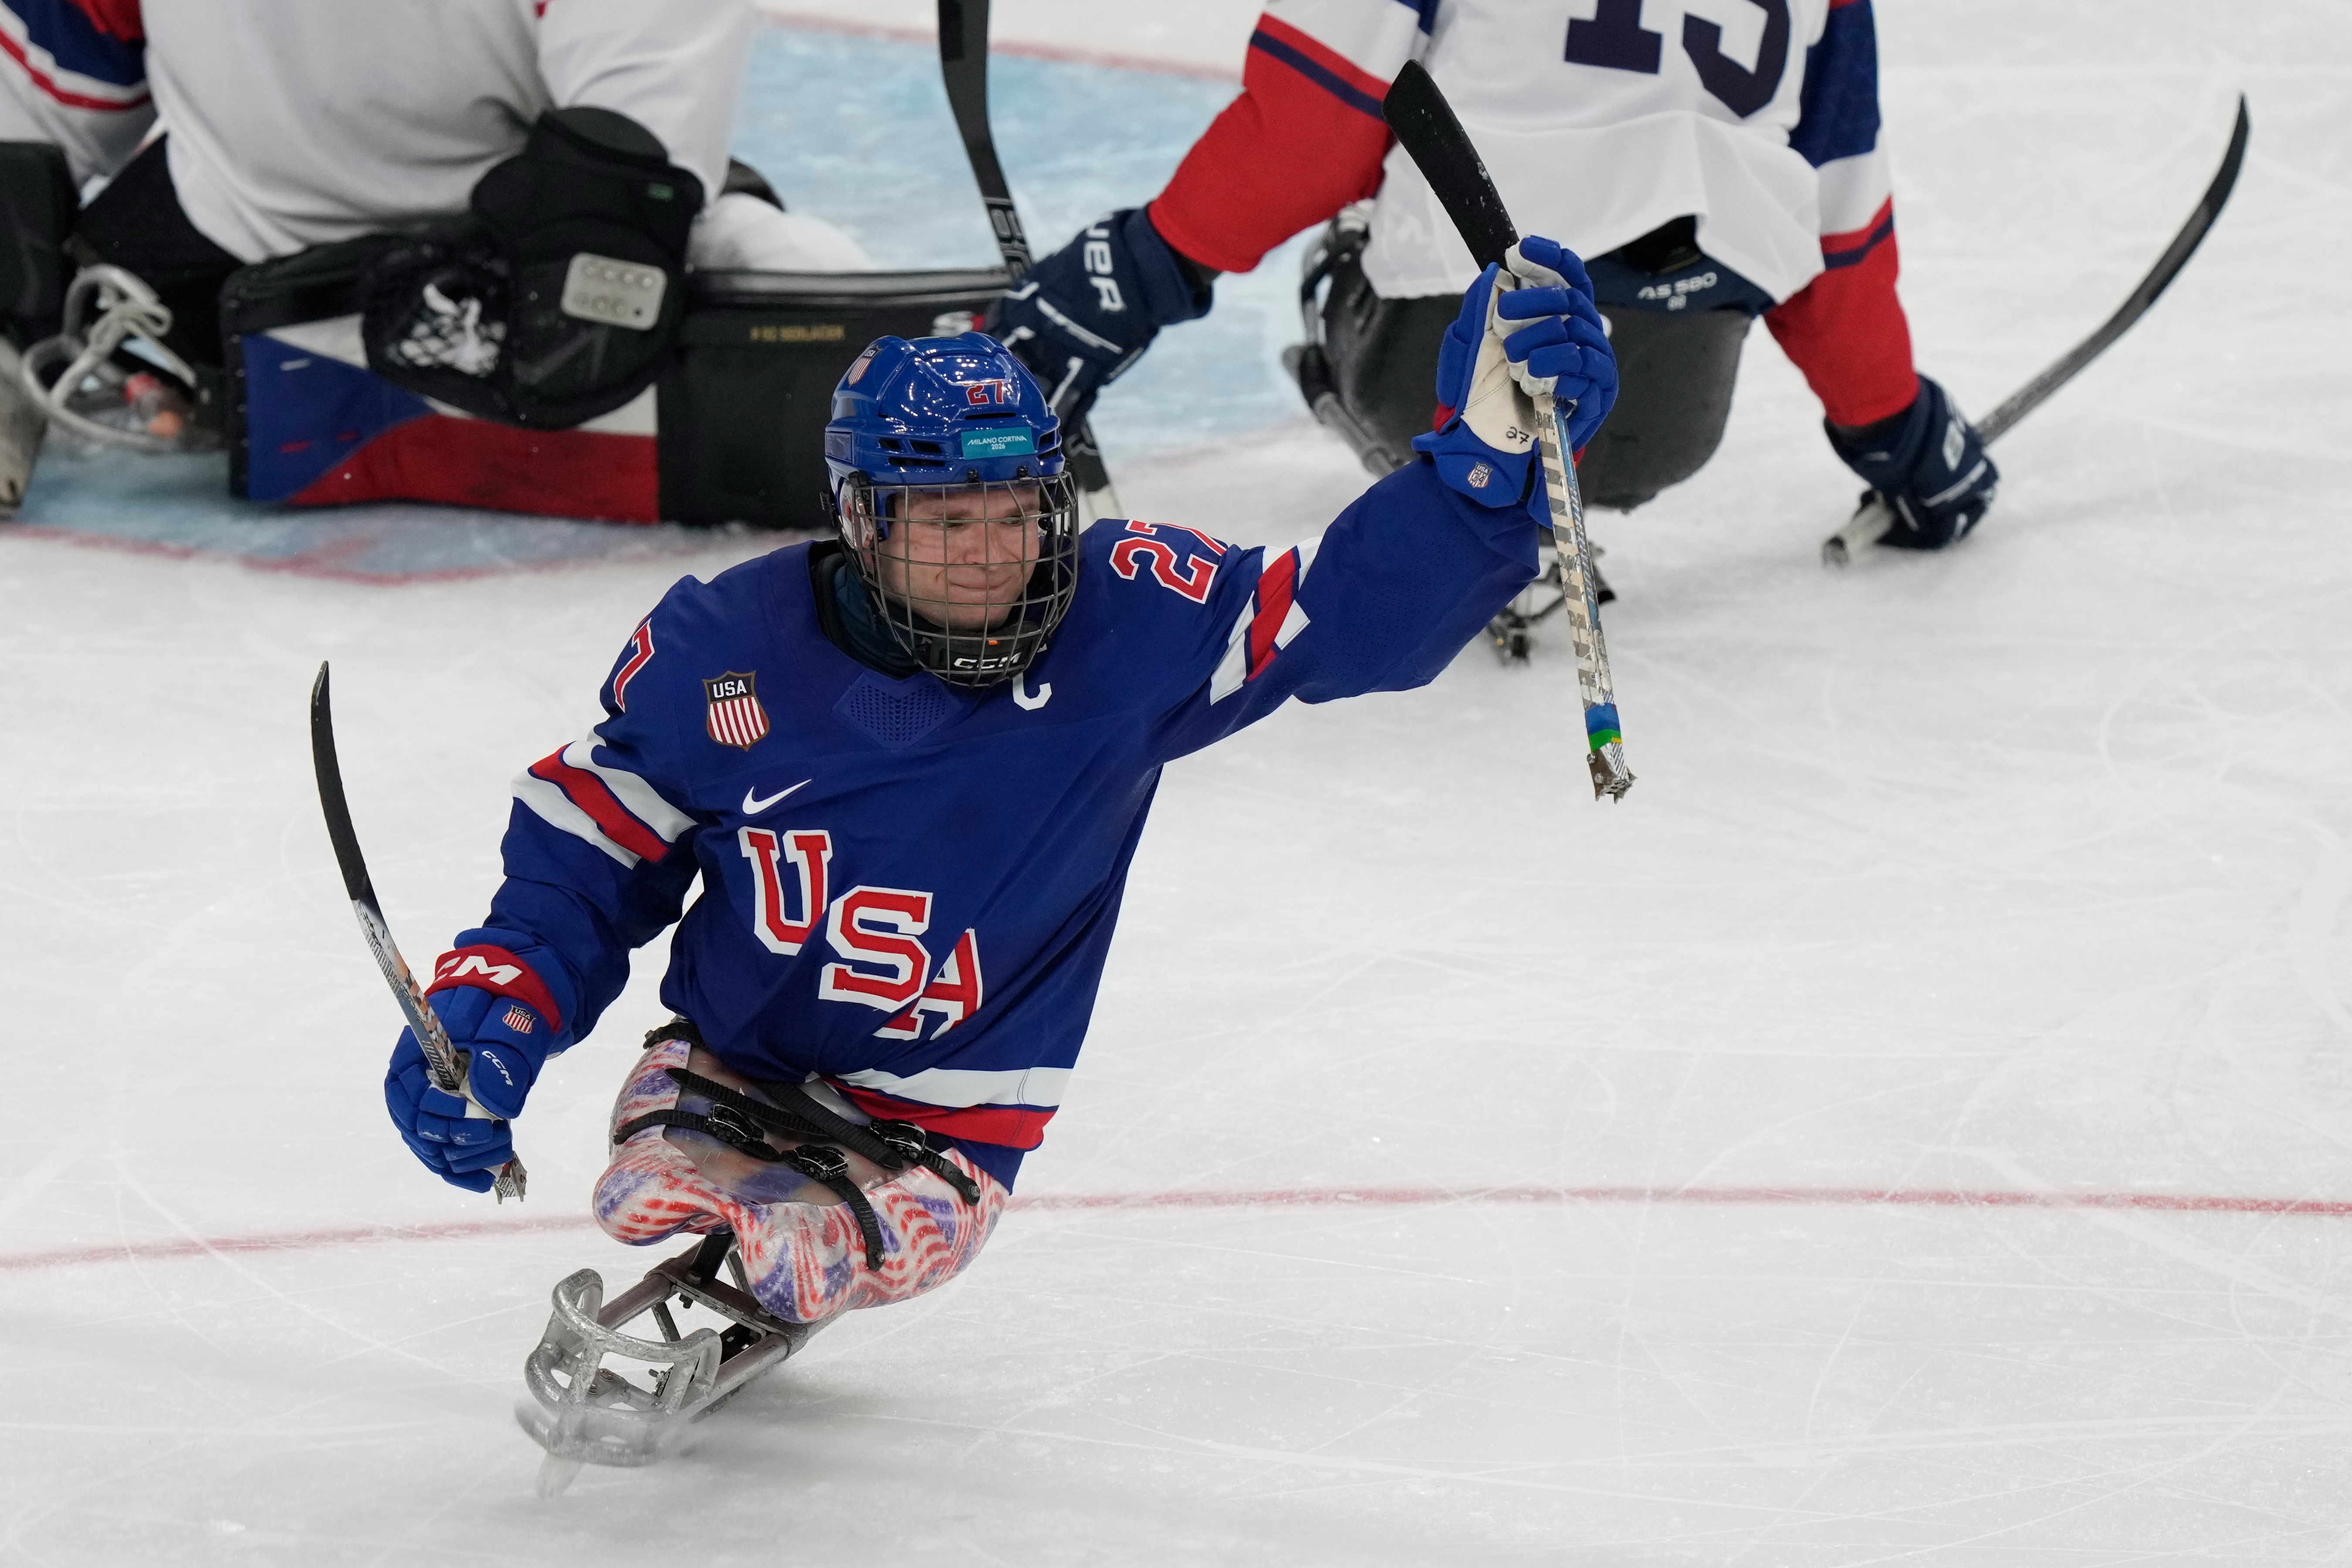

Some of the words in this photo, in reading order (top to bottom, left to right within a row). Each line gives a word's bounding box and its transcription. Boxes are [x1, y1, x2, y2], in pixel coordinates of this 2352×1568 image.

[963, 379, 1005, 405] 27
[967, 437, 997, 445] MILANO
[998, 435, 1028, 443] CORTINA
[1506, 426, 1530, 444] 27
[1476, 465, 1488, 474] USA
[613, 617, 655, 713] 7
[954, 652, 1022, 669] CCM
[713, 679, 747, 698] USA
[737, 826, 983, 1041] USA
[433, 956, 523, 986] CM
[515, 1008, 531, 1020] USA
[482, 1050, 513, 1086] CCM
